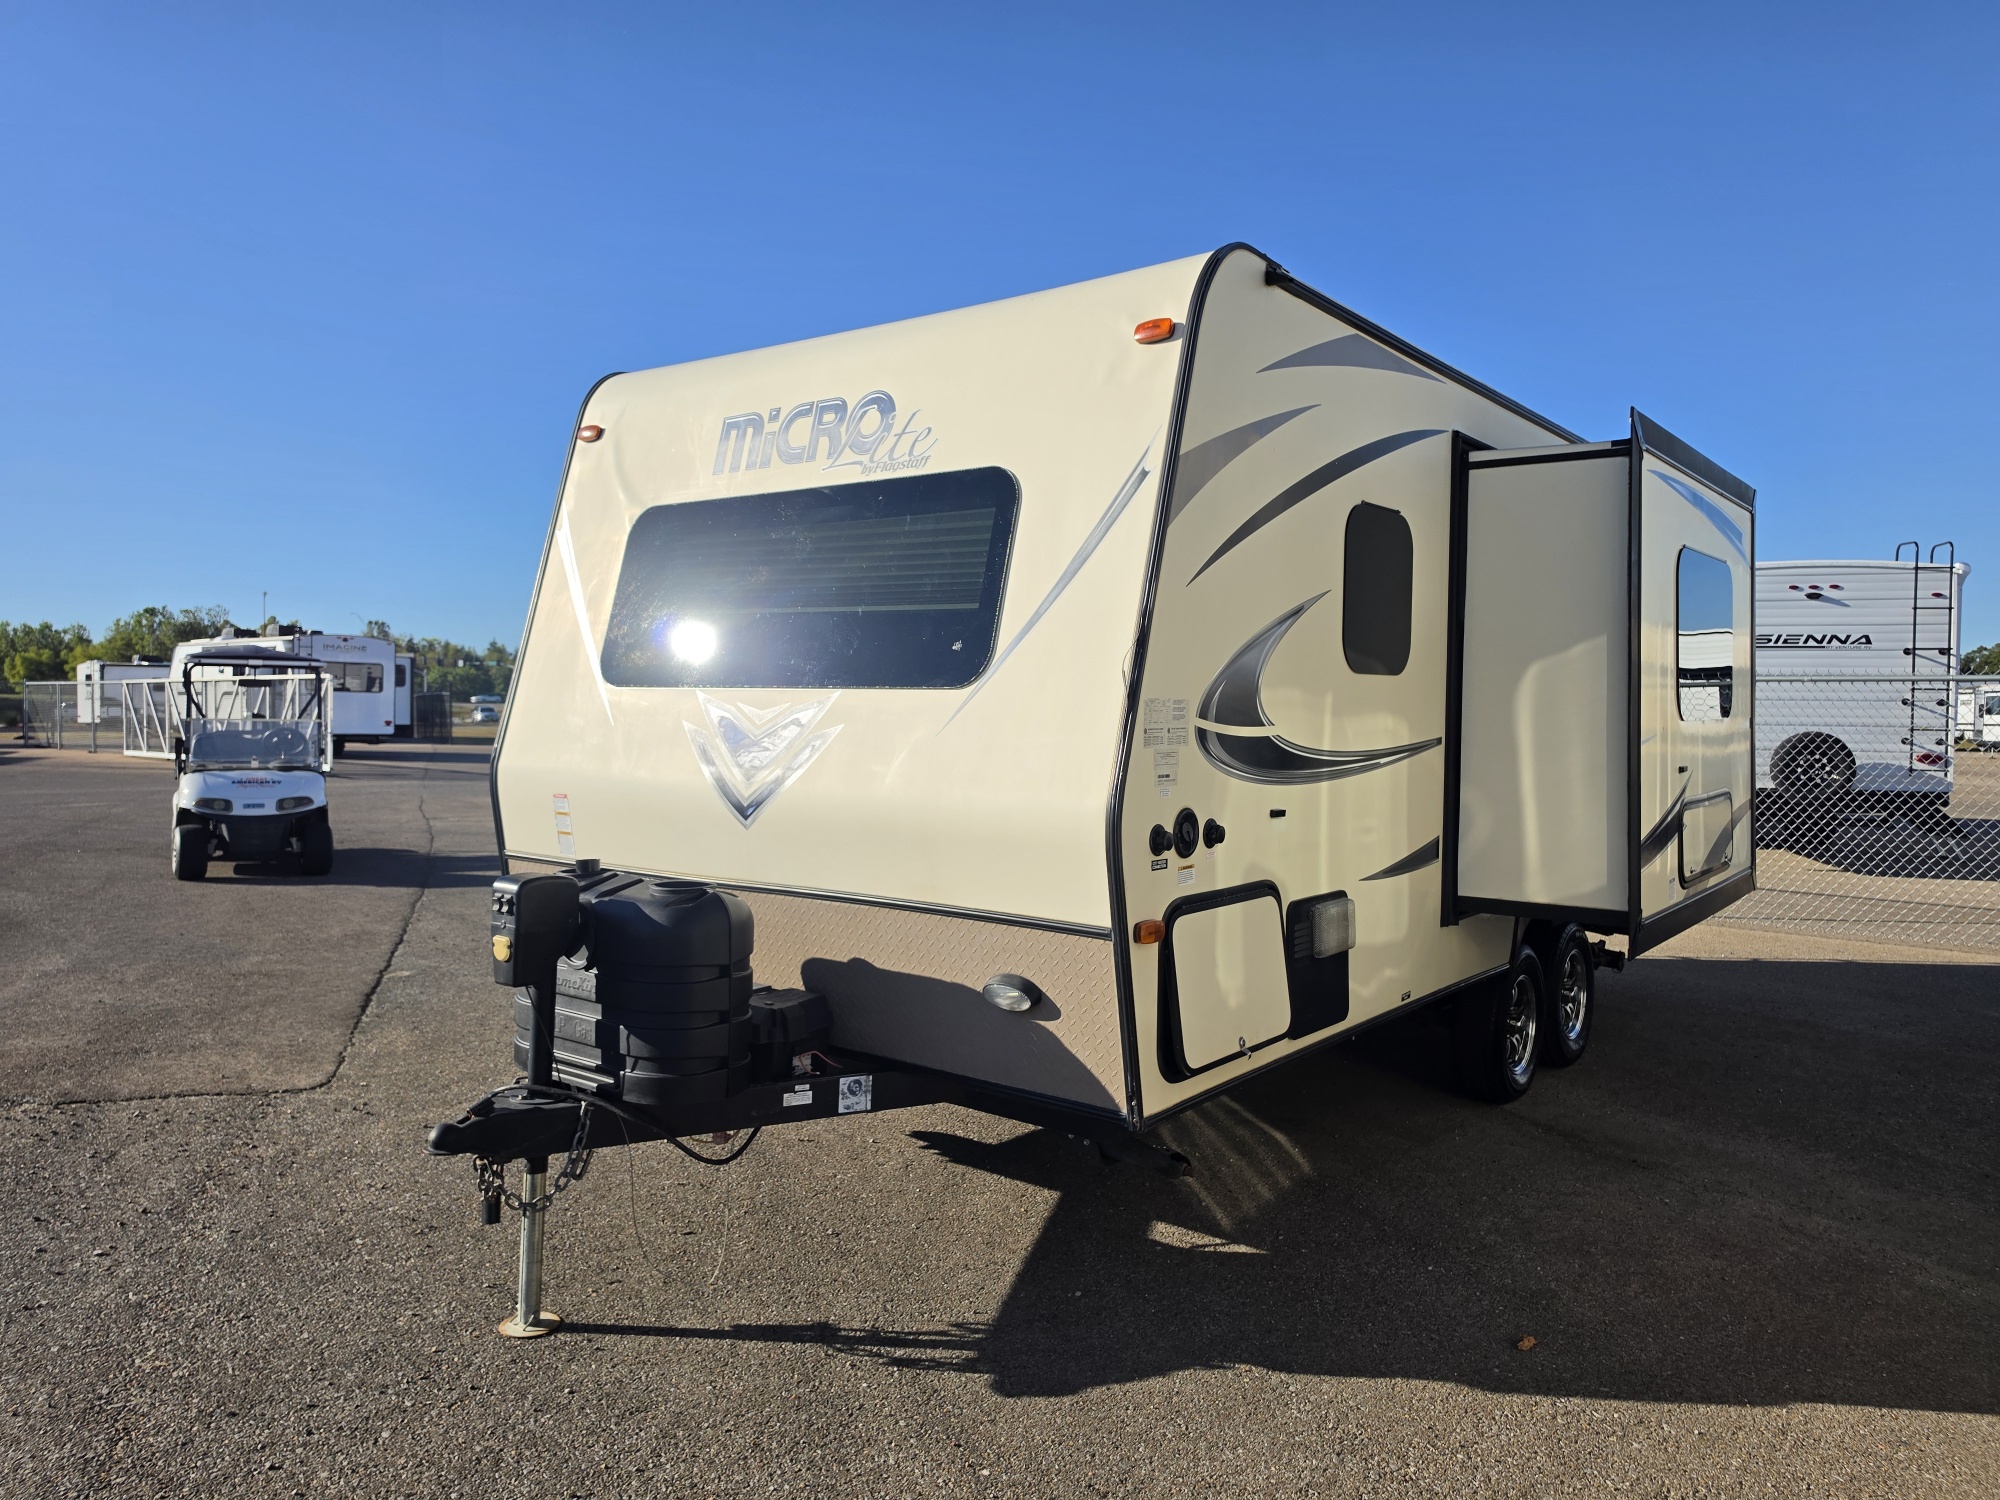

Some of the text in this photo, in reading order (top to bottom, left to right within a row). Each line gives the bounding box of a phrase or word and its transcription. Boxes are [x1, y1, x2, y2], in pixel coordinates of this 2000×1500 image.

[860, 454, 932, 476] by Flagstaff
[322, 643, 368, 652] IMAGINE
[1756, 634, 1873, 645] SIENNA
[574, 1019, 593, 1042] Gas
